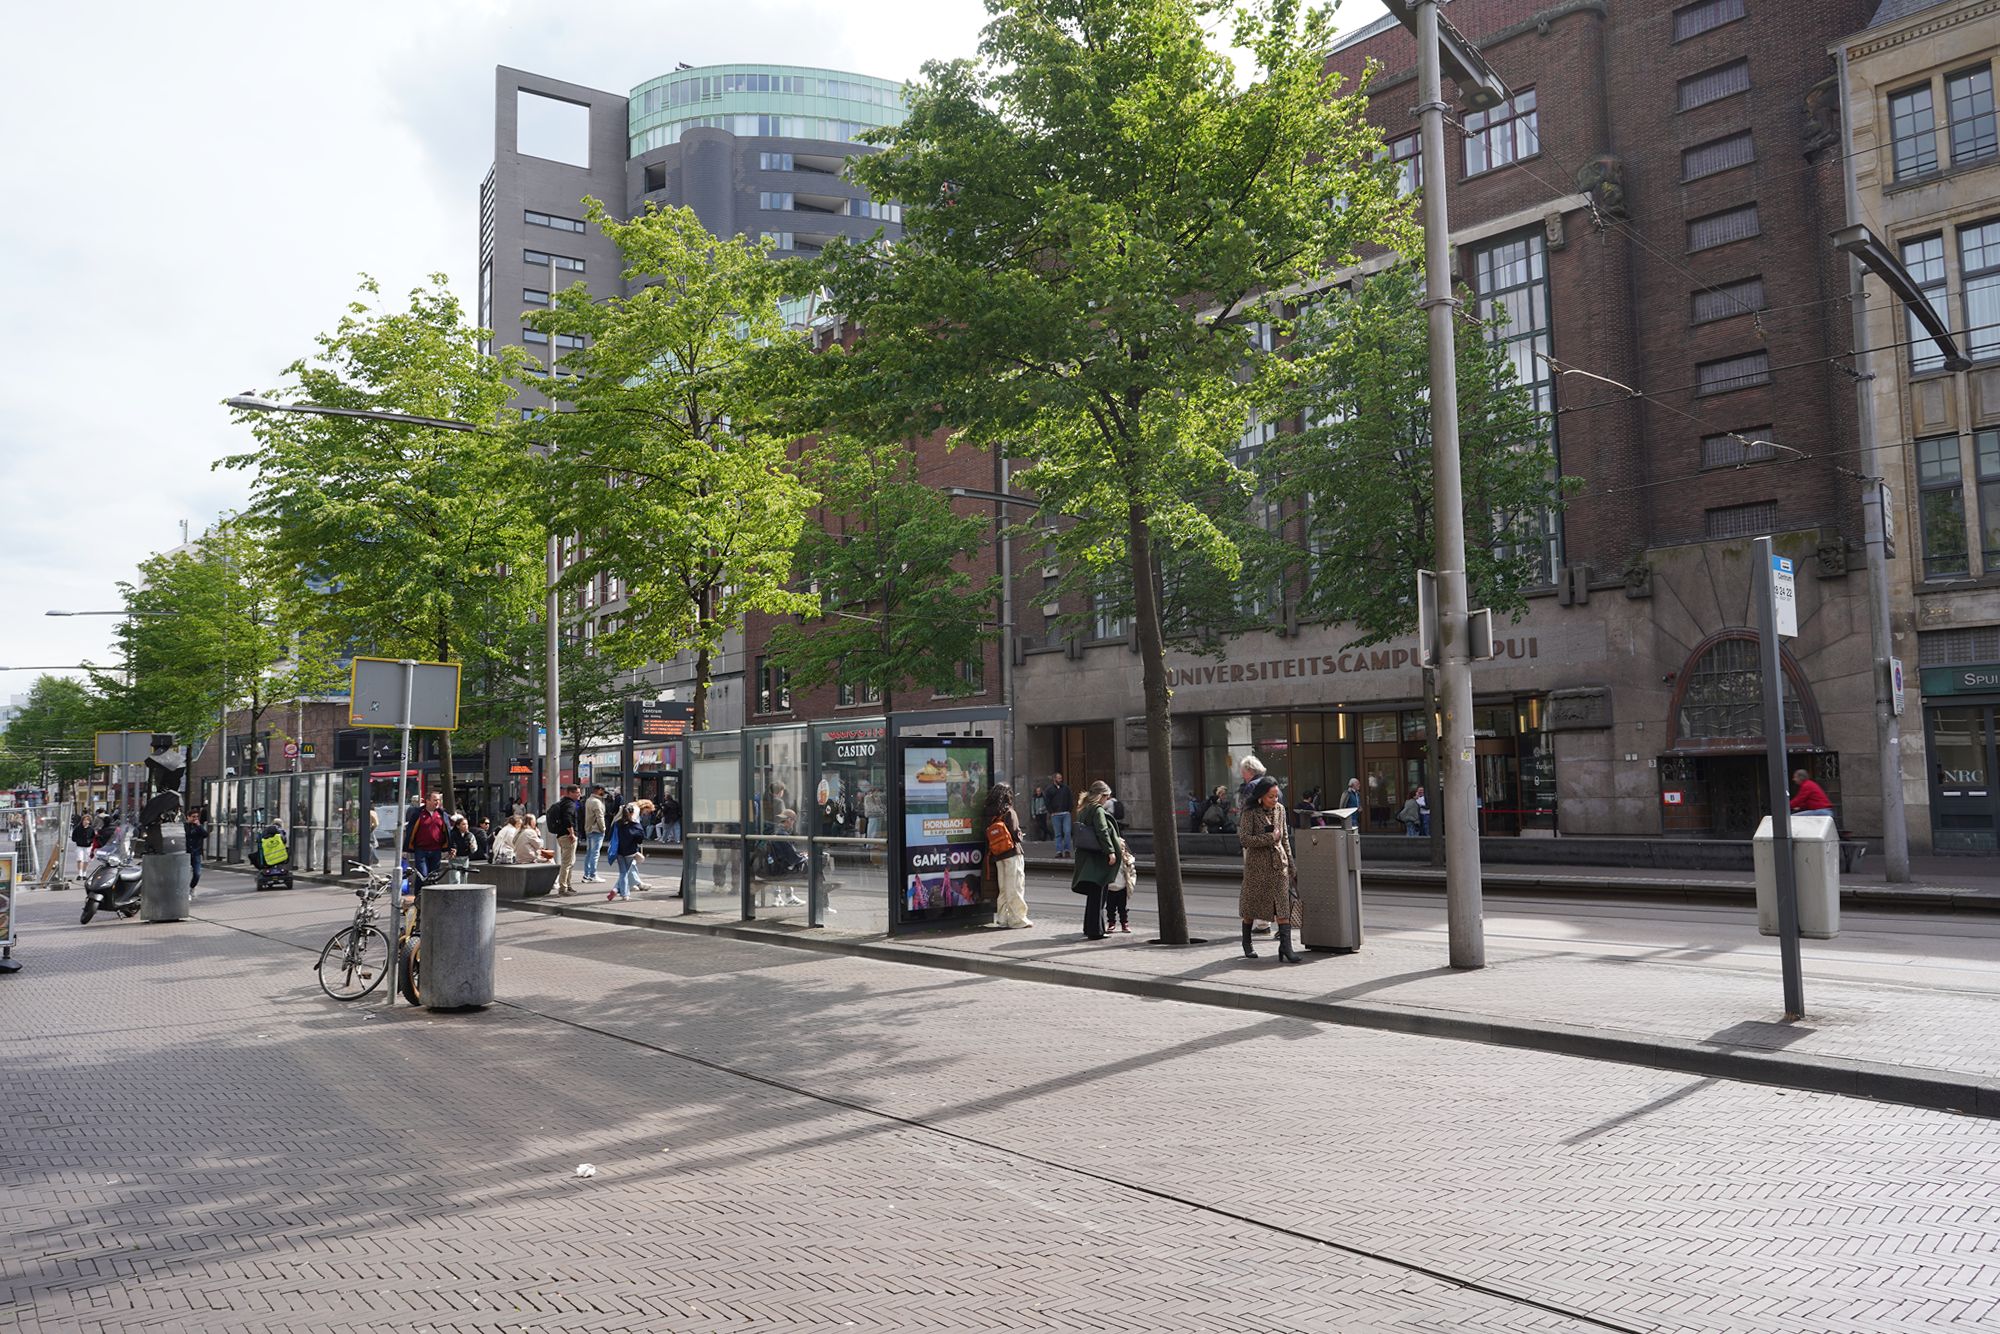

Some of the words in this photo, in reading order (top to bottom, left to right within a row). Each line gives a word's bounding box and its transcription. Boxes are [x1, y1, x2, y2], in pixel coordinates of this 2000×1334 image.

[1167, 648, 1422, 687] UNIVERSITEITSCAMPU
[1492, 637, 1538, 661] PUI
[837, 744, 876, 758] CASINO
[1943, 770, 1984, 783] NRC
[924, 818, 964, 829] HORNBACH
[912, 853, 947, 867] GAME
[950, 852, 970, 865] ON
